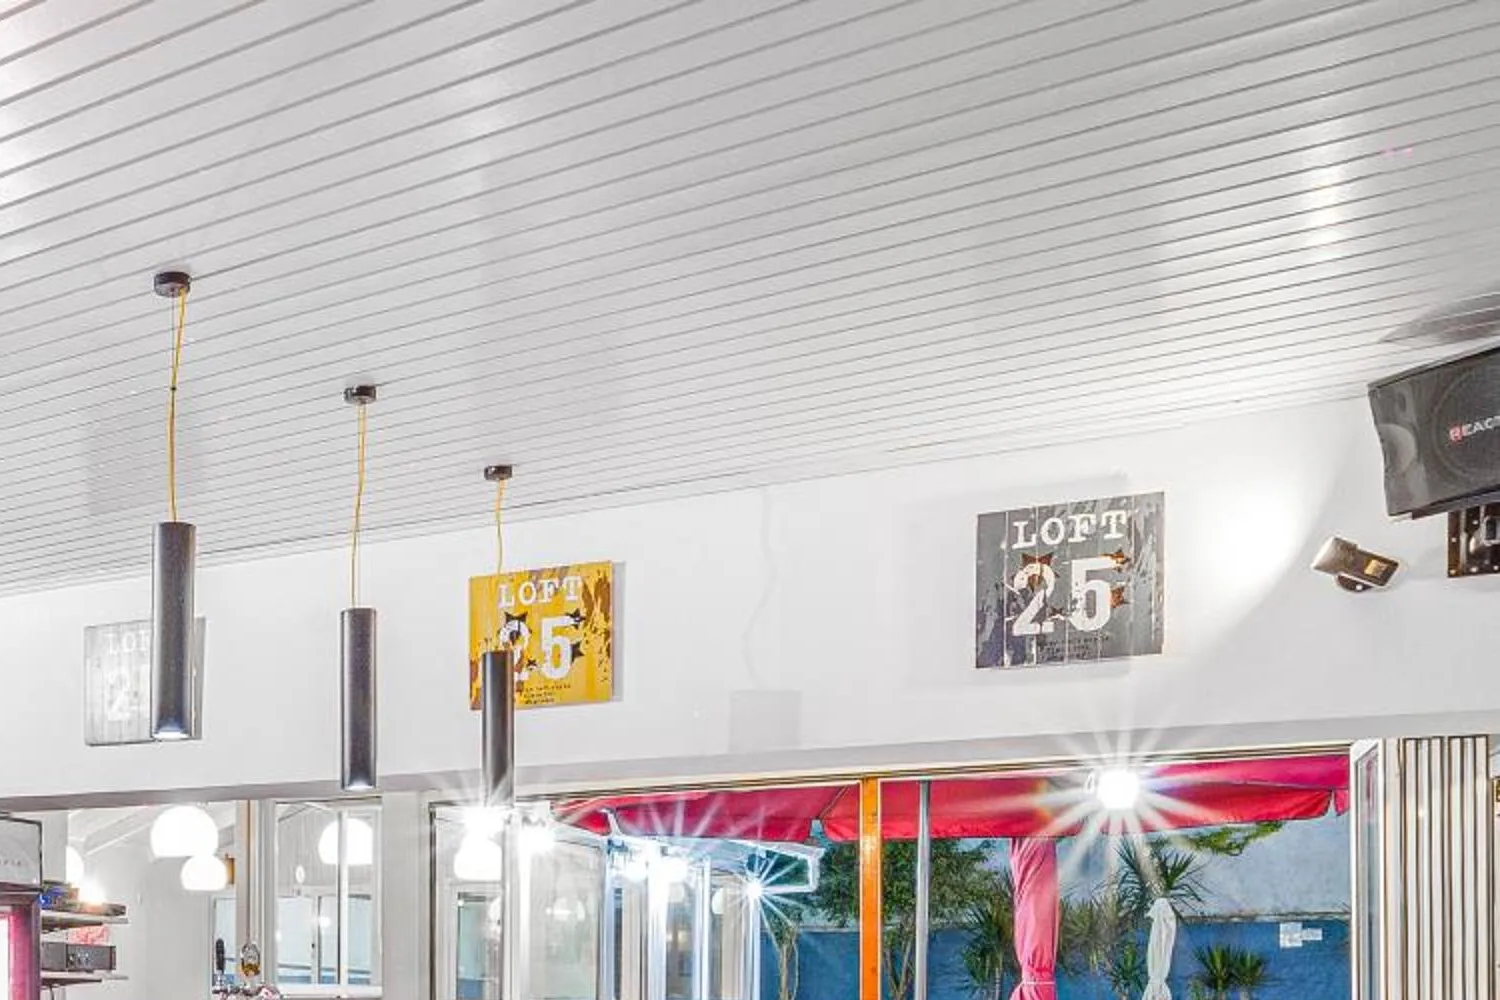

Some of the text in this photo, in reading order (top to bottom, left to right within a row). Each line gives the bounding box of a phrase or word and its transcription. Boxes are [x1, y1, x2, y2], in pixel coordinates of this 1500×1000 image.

[1450, 415, 1500, 442] REAC
[1011, 510, 1127, 550] LOFT
[498, 575, 582, 608] LOFT
[1011, 556, 1118, 637] 25
